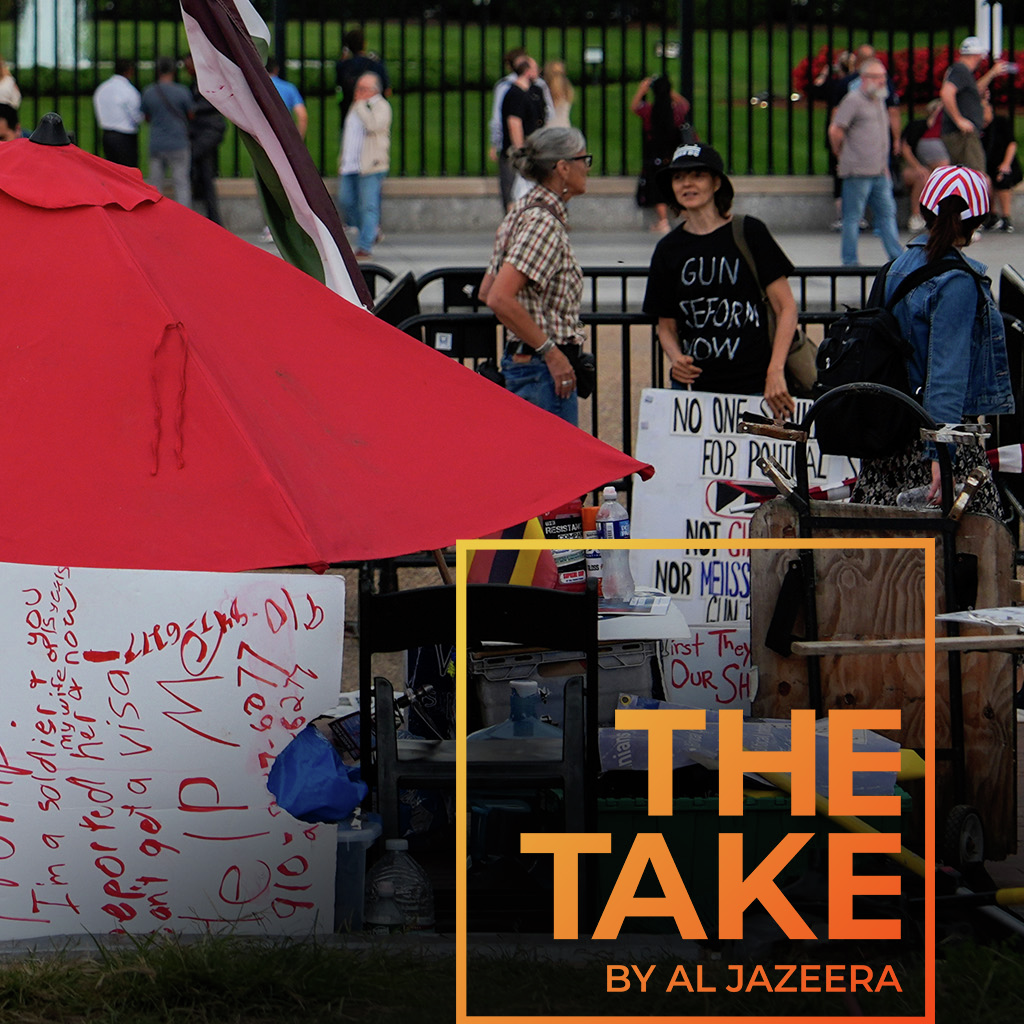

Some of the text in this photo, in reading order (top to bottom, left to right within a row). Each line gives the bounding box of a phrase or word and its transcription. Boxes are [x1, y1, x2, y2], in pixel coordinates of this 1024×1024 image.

[682, 256, 740, 286] GUN
[673, 396, 702, 434] NO
[712, 396, 748, 434] ONE
[701, 439, 737, 478] FOR
[686, 519, 721, 556] NOT
[655, 559, 750, 599] NOR MELISS
[21, 588, 43, 646] you
[63, 586, 80, 665] now
[42, 632, 58, 663] of
[671, 629, 750, 667] irst They
[48, 666, 69, 716] wife
[156, 621, 241, 747] Me
[60, 721, 76, 750] my
[69, 710, 106, 761] her
[26, 704, 62, 812] soldier
[126, 776, 152, 795] a
[41, 833, 66, 850] a
[121, 803, 180, 857] get
[65, 775, 147, 934] eported
